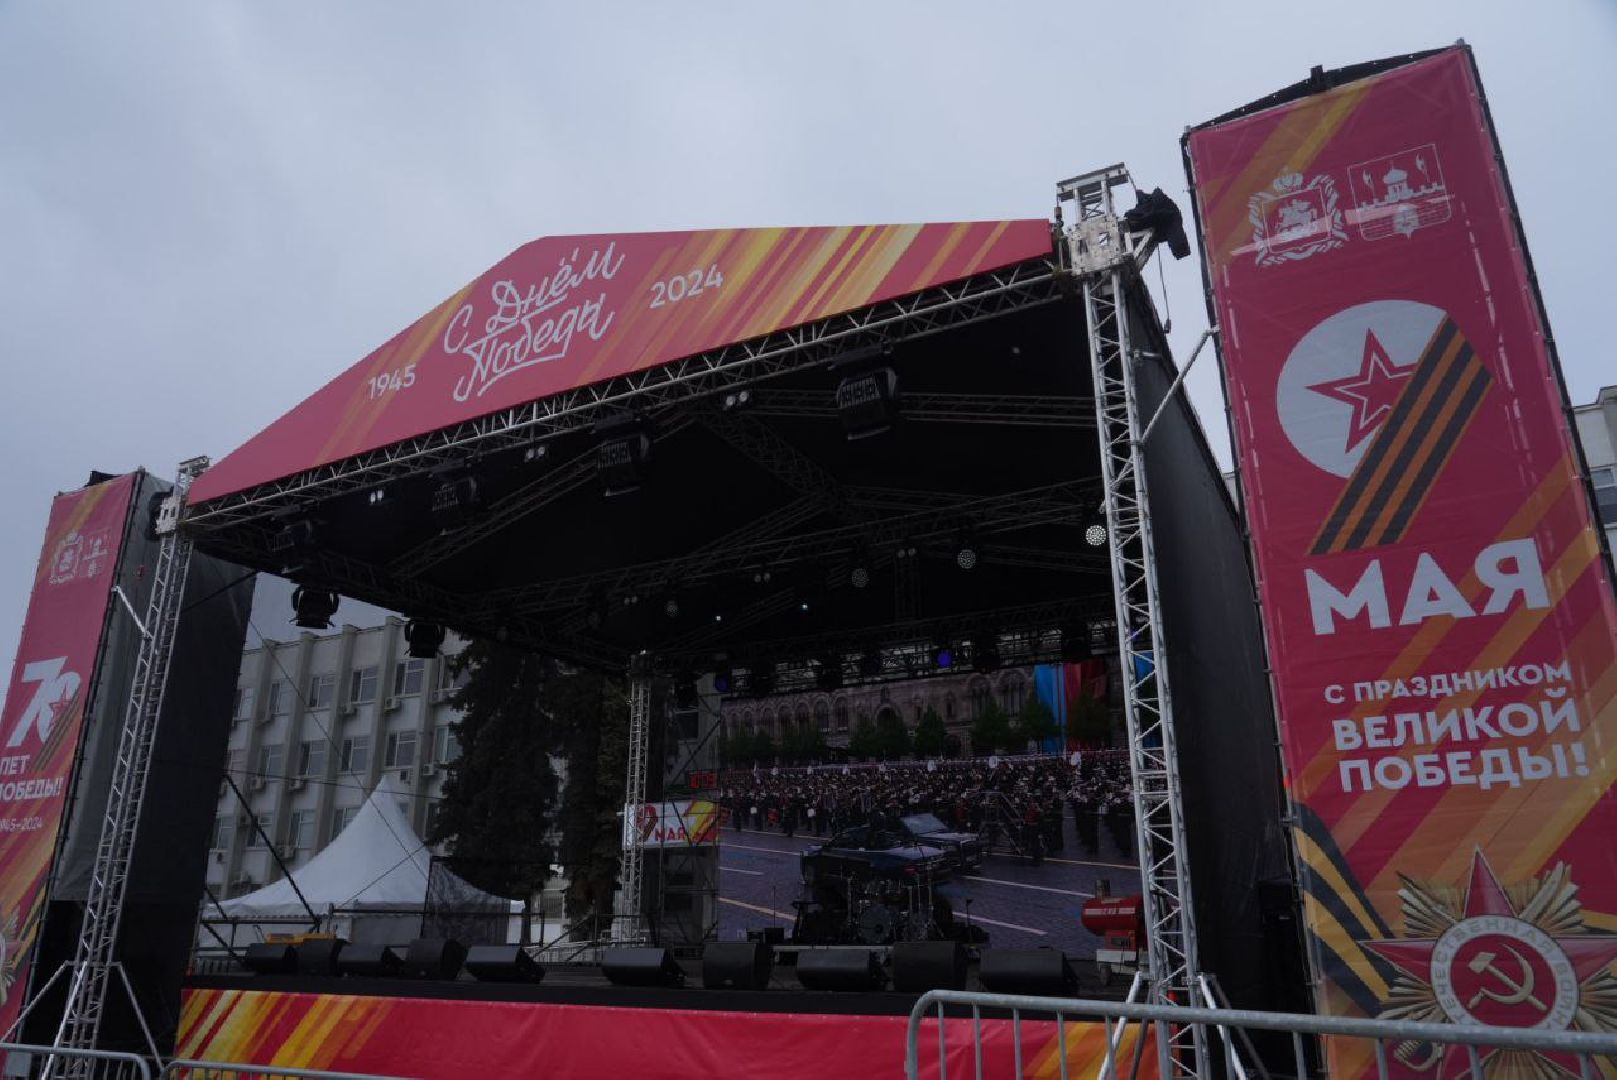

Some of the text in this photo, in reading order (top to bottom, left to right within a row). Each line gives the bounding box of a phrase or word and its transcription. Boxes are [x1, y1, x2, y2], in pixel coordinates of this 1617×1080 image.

[650, 264, 724, 309] 2024
[367, 364, 416, 399] 1945
[1303, 537, 1551, 636] МАЯ
[1353, 658, 1573, 702] ПРАЗДНИКОМ
[1331, 687, 1581, 751] ВЕЛИКОЙ
[1339, 742, 1590, 792] ПОБЕДЫ!
